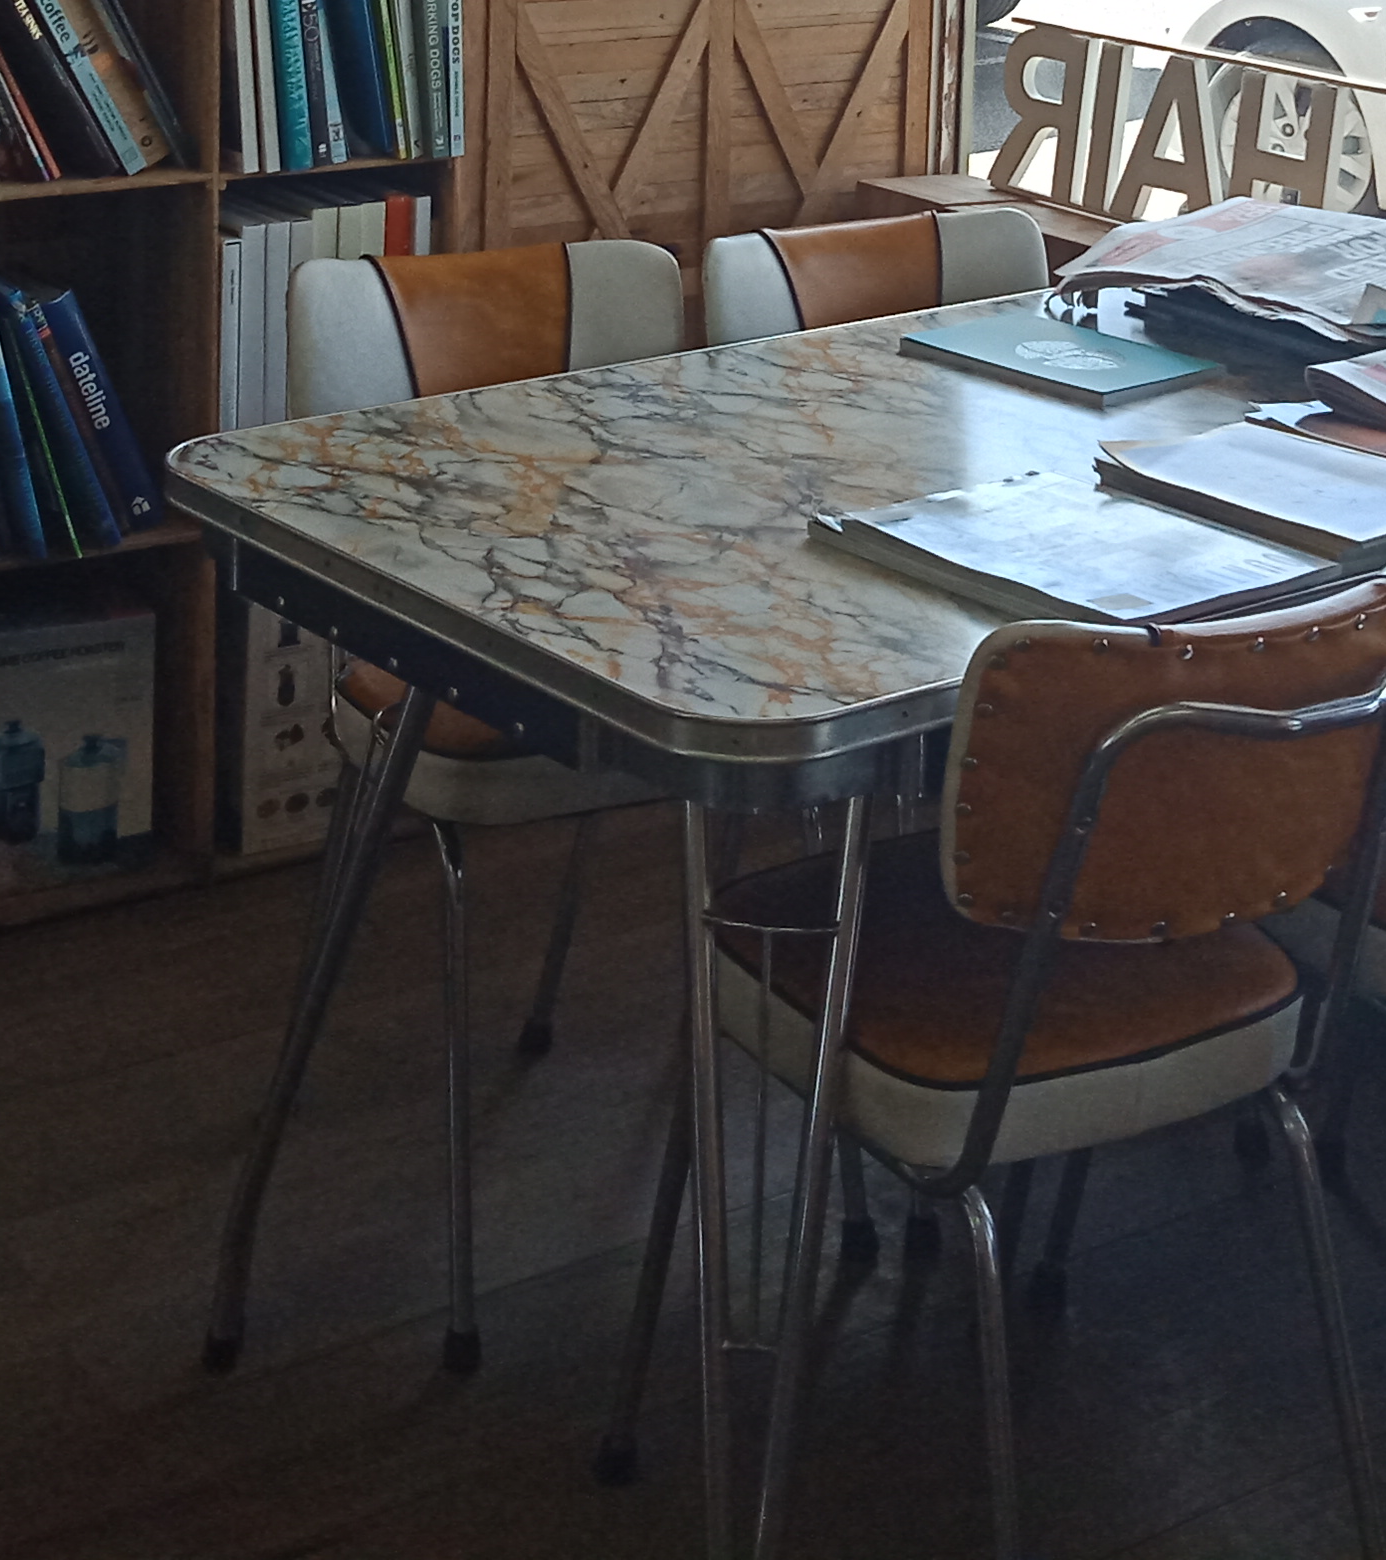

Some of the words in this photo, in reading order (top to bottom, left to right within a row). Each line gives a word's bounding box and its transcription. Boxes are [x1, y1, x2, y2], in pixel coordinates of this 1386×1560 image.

[302, 12, 320, 43] 50
[451, 25, 462, 65] DOGS
[428, 48, 443, 89] DOGS
[66, 348, 117, 432] dateline
